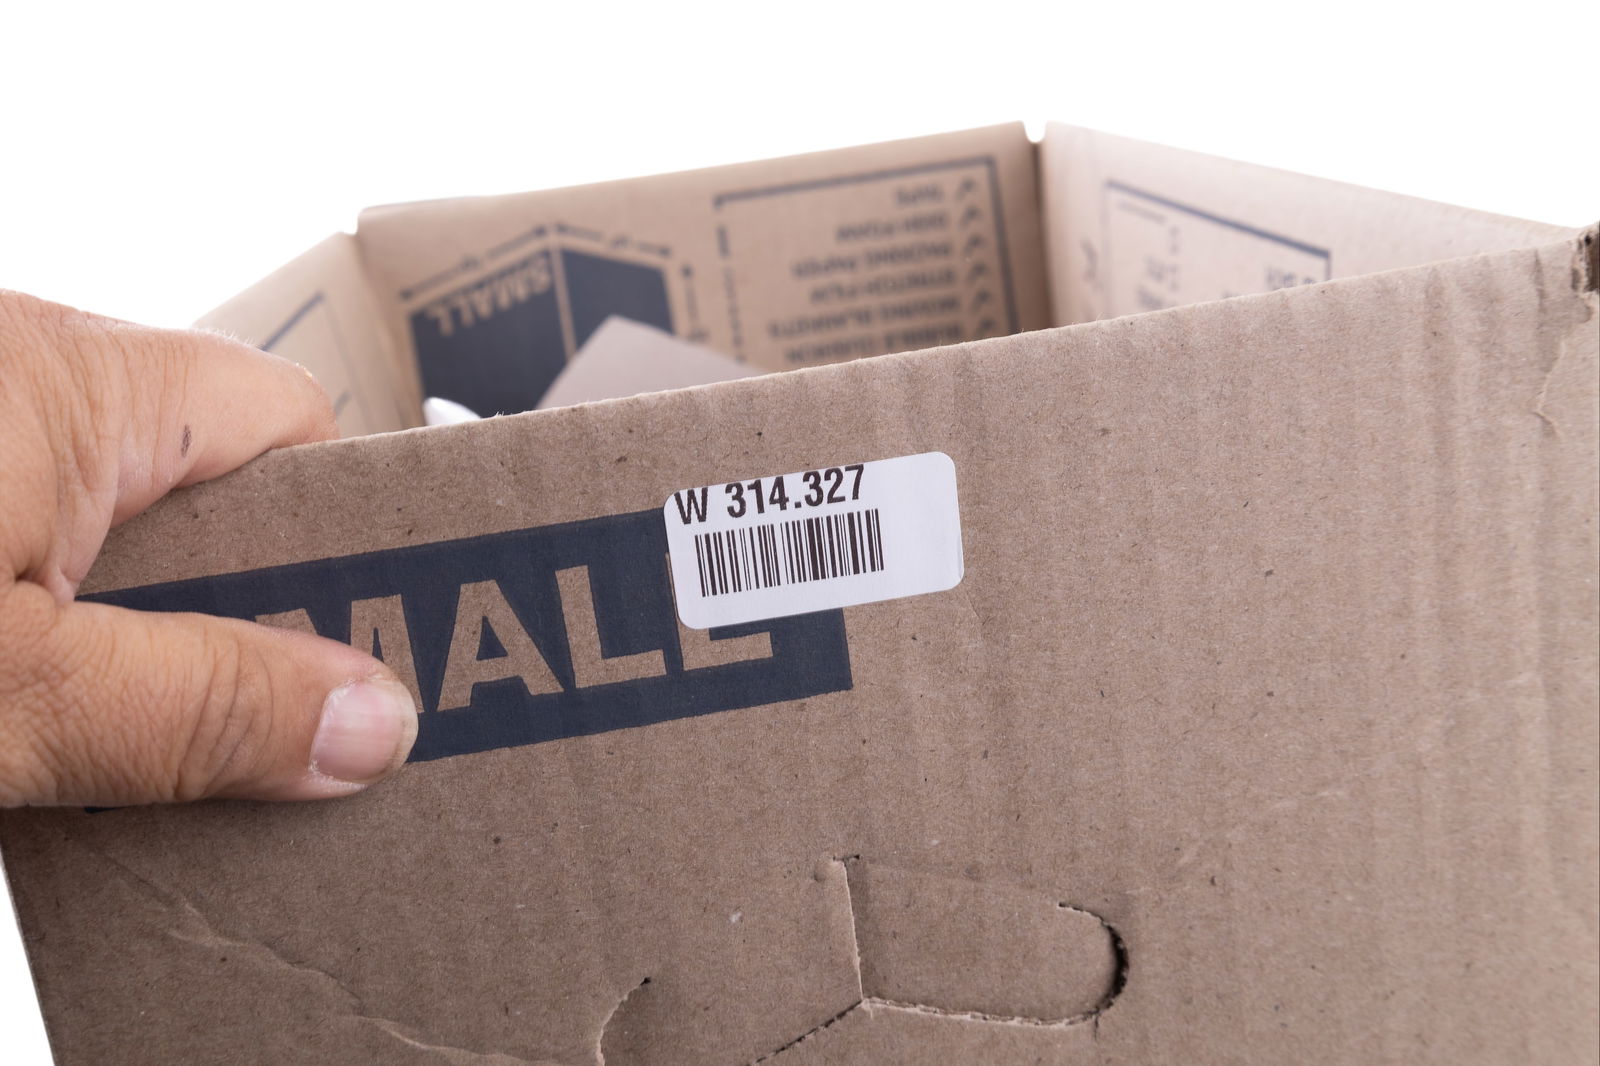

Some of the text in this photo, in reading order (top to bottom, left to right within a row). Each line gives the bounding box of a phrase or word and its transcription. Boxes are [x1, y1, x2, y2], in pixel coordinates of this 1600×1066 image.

[424, 254, 552, 337] SMALL
[674, 463, 865, 525] W 314.327
